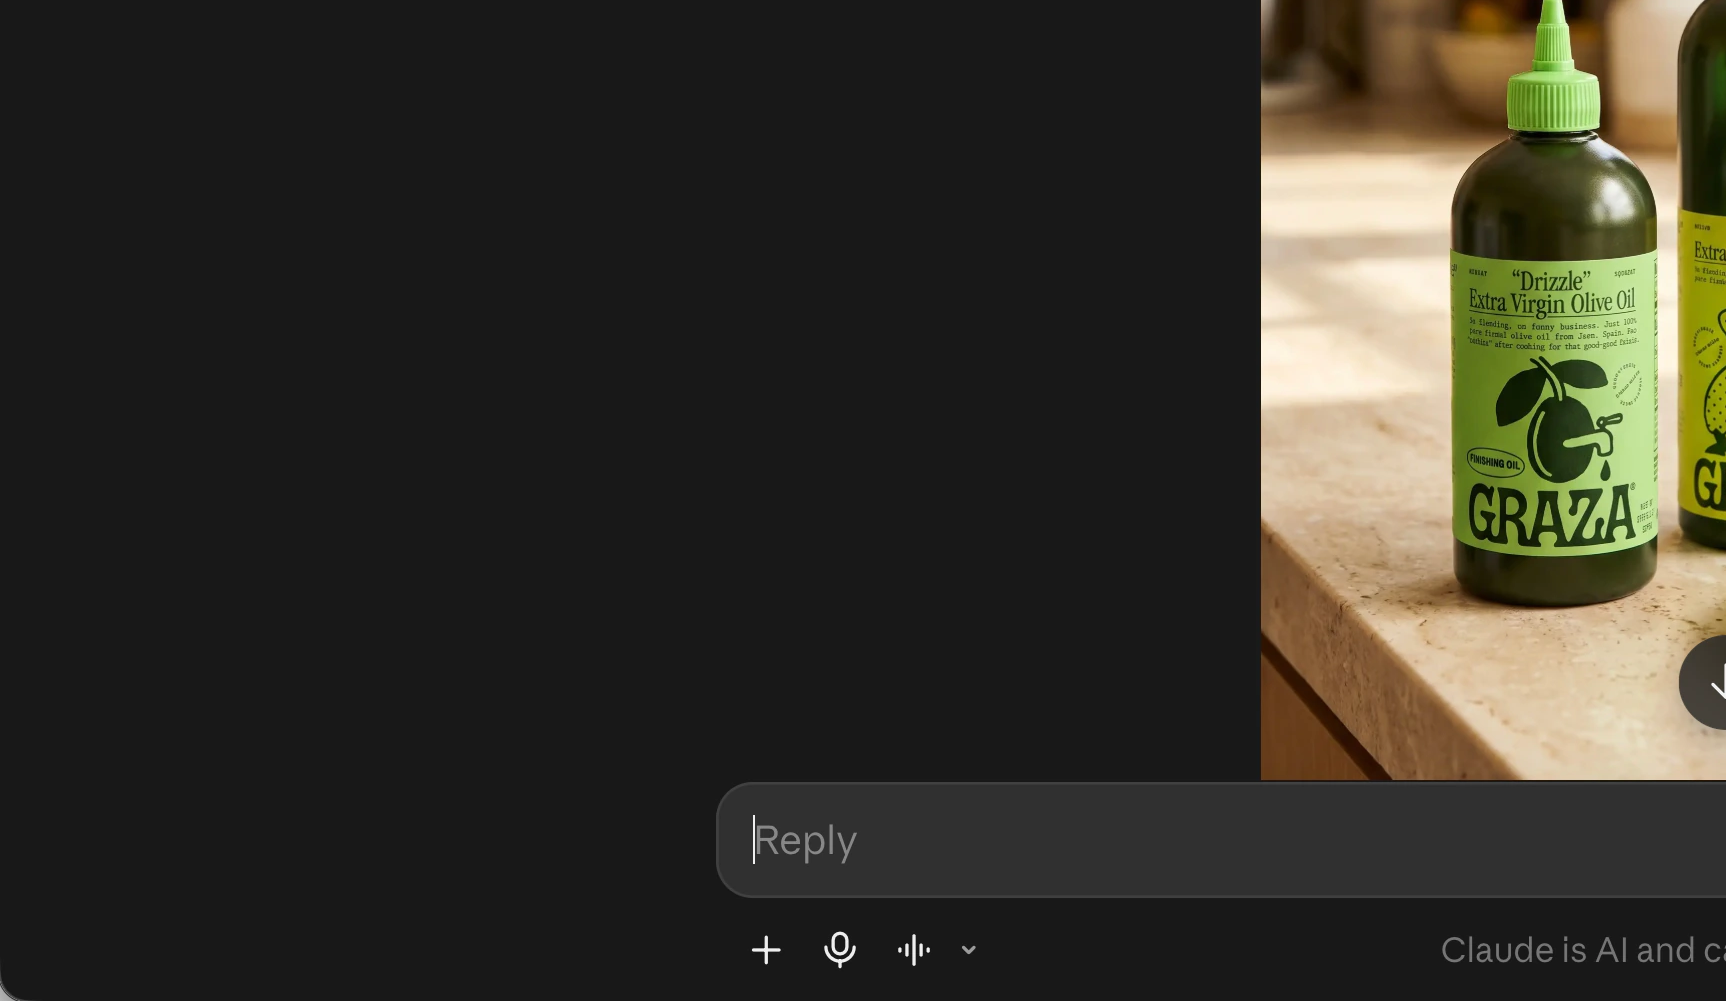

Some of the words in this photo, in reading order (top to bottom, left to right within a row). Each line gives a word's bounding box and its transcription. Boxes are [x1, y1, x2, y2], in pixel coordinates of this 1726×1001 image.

[1695, 241, 1726, 262] Extra
[1512, 269, 1591, 291] “Drizzle”
[1469, 288, 1507, 312] Extra
[1511, 293, 1565, 320] Virgin
[1571, 290, 1613, 314] Olive
[1617, 287, 1636, 309] Oil
[1510, 332, 1532, 340] olive
[1536, 332, 1550, 341] oil
[1555, 333, 1574, 341] from
[1602, 329, 1624, 339] Spain.
[1560, 323, 1599, 331] business.
[1604, 320, 1620, 328] Just
[1494, 340, 1513, 349] after
[1548, 342, 1562, 351] for
[1565, 342, 1581, 350] that
[1470, 453, 1505, 468] FINISHING
[1506, 460, 1520, 470] OIL
[756, 824, 858, 864] Reply
[1442, 936, 1553, 963] Claude
[1564, 936, 1586, 963] is
[1596, 937, 1626, 962] AI
[1638, 936, 1694, 963] and
